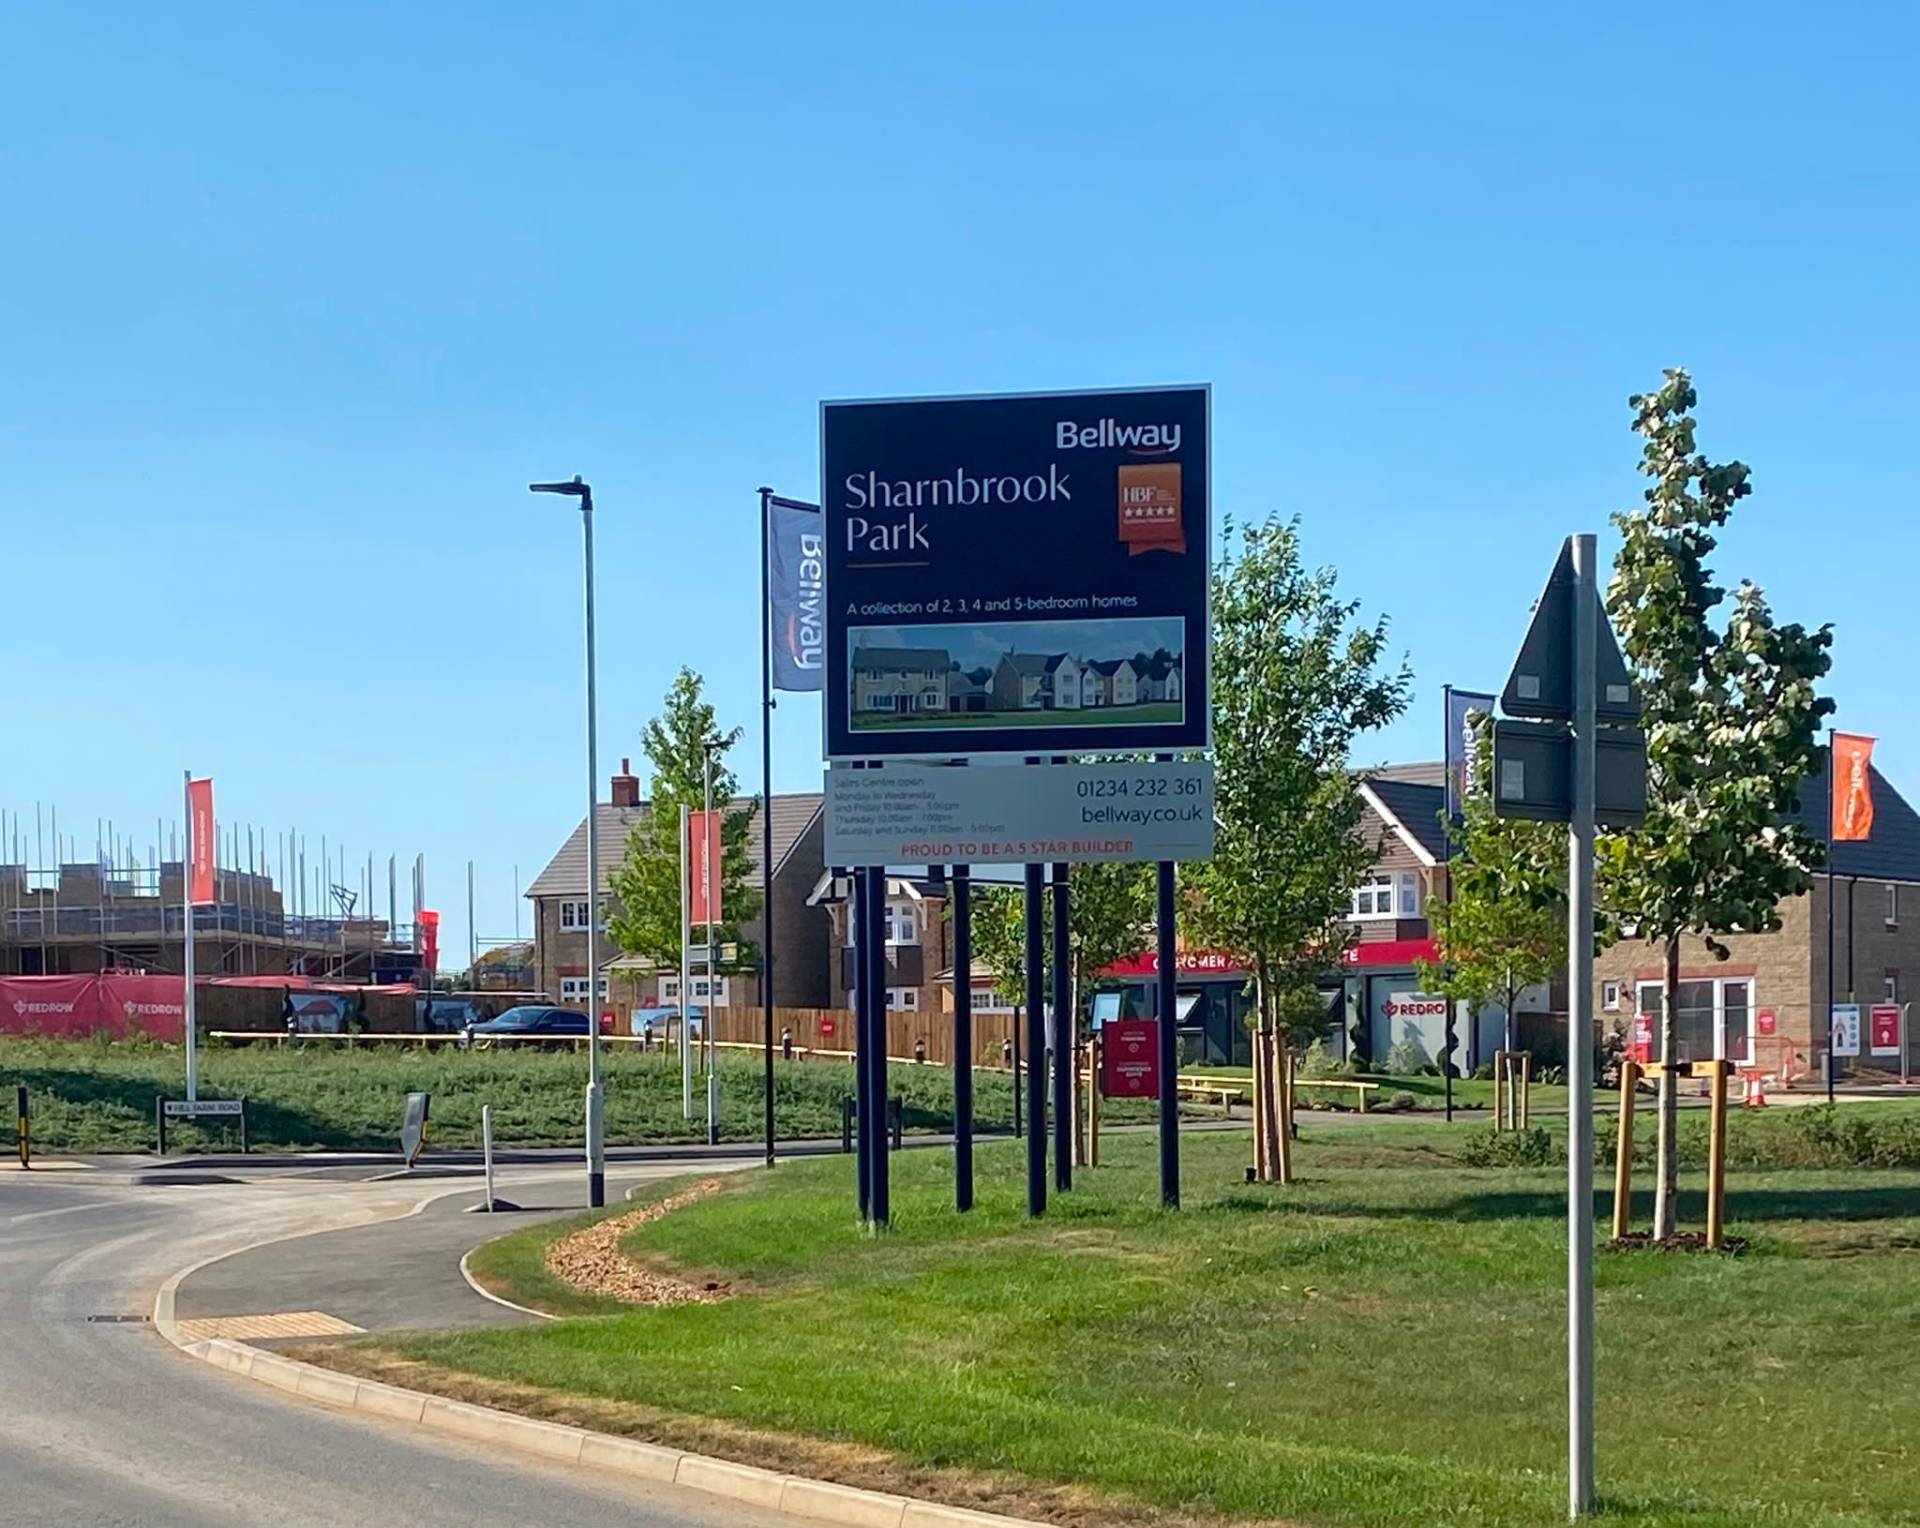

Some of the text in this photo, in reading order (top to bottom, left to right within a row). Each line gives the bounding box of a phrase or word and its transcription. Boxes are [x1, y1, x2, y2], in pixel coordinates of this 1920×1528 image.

[1056, 418, 1181, 453] Bellway
[845, 462, 1071, 509] Sharnbrook
[1123, 486, 1157, 504] HBF
[846, 512, 930, 552] Park
[793, 533, 823, 670] Bellway
[846, 602, 858, 615] A
[860, 602, 922, 615] collection
[926, 599, 940, 613] of
[972, 598, 981, 611] 4
[984, 597, 1011, 612] and
[1014, 595, 1088, 610] 5-bedroom
[1092, 594, 1139, 609] homes
[1076, 777, 1203, 798] 01234 232 361
[1081, 803, 1203, 826] bellway.co.uk
[901, 840, 1134, 857] PROUD TO BE A 5 STAR BUILDER
[28, 1002, 75, 1013] REDROW
[137, 1002, 183, 1015] REDROW
[1400, 1002, 1445, 1016] REDRO
